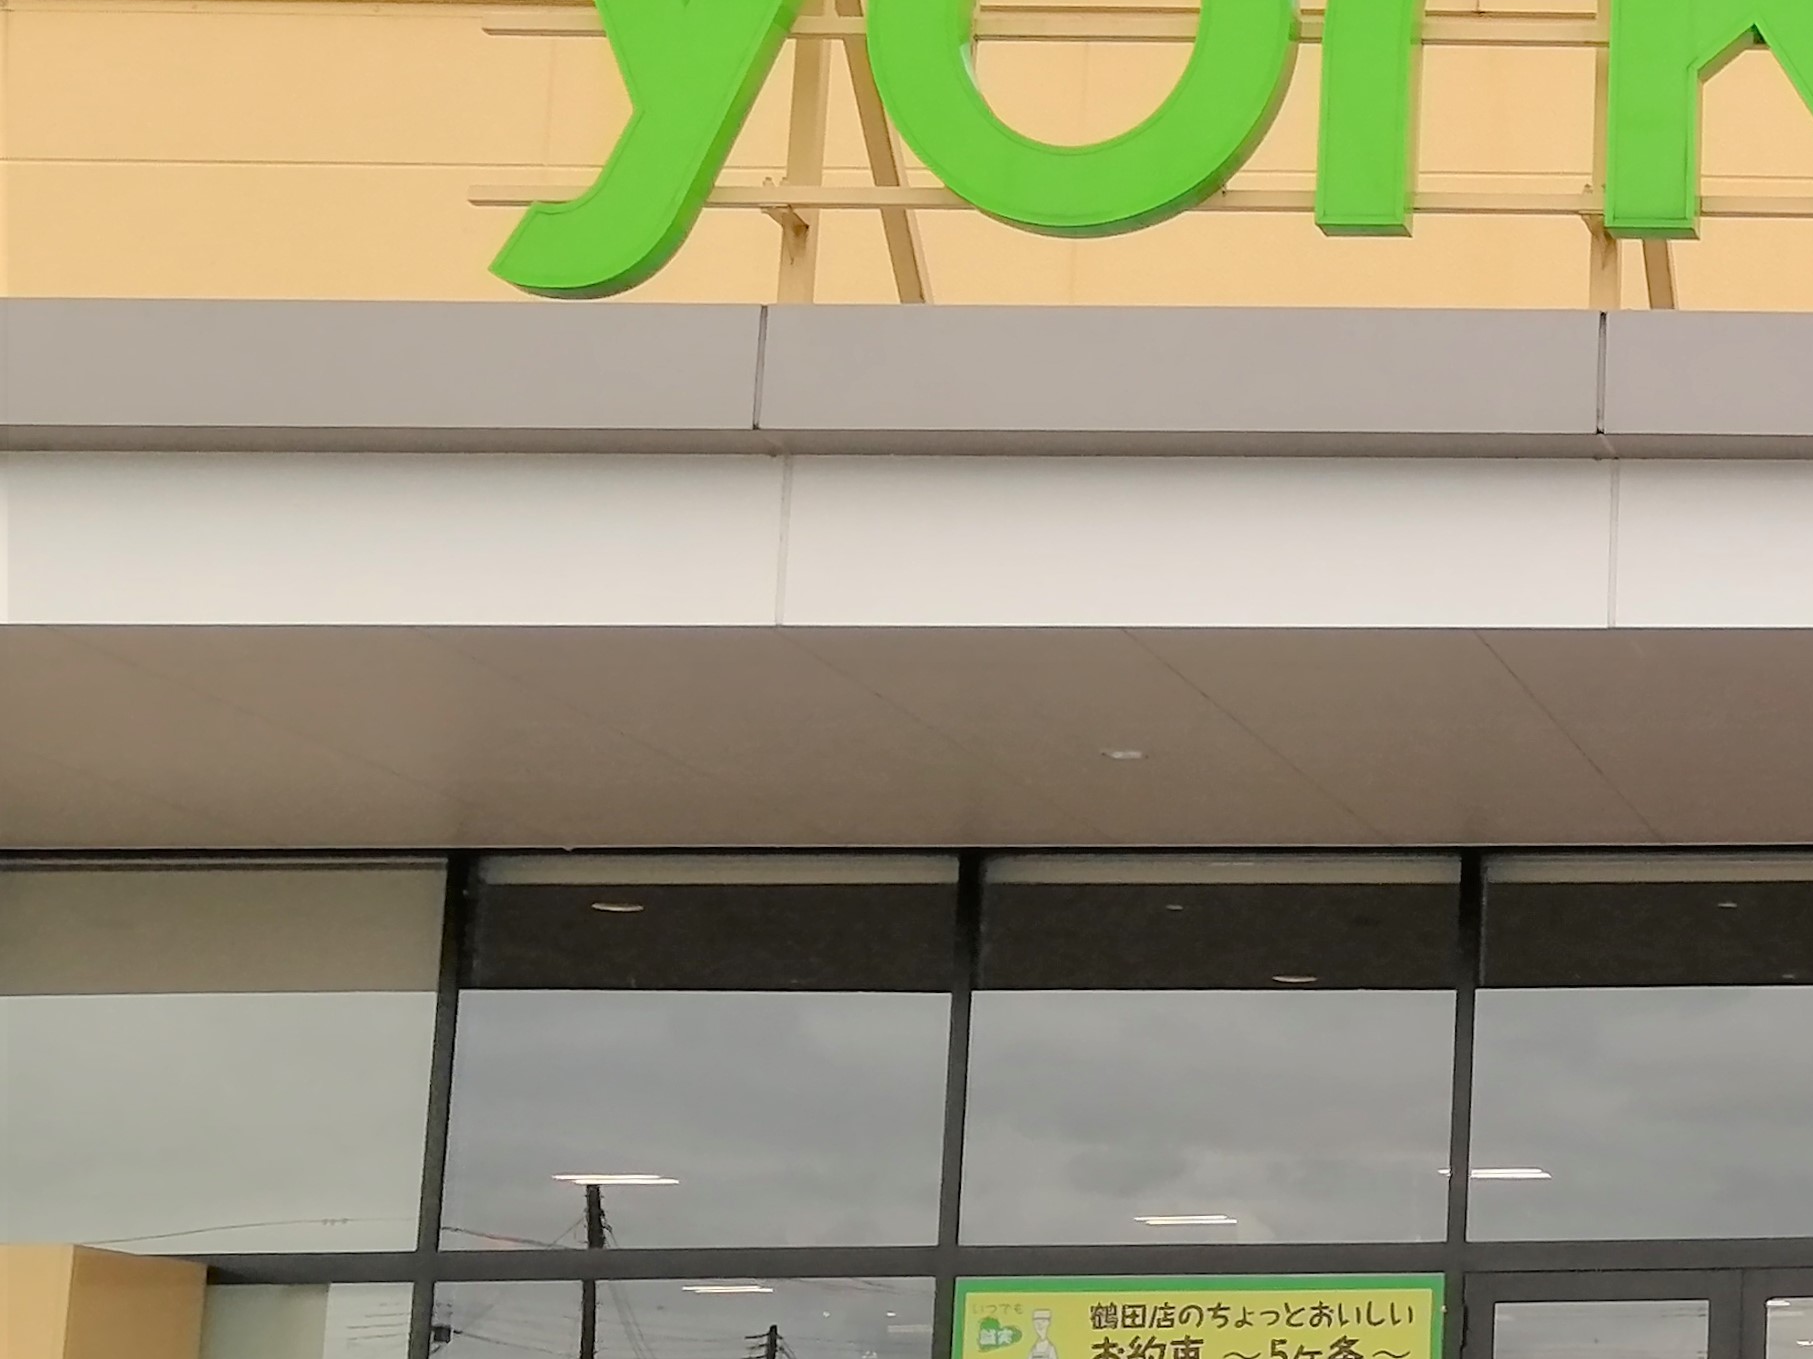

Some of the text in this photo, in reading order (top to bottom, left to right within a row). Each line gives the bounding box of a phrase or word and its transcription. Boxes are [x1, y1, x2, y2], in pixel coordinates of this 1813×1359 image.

[1089, 1300, 1415, 1330] 鶴田店のちょっとおいしい
